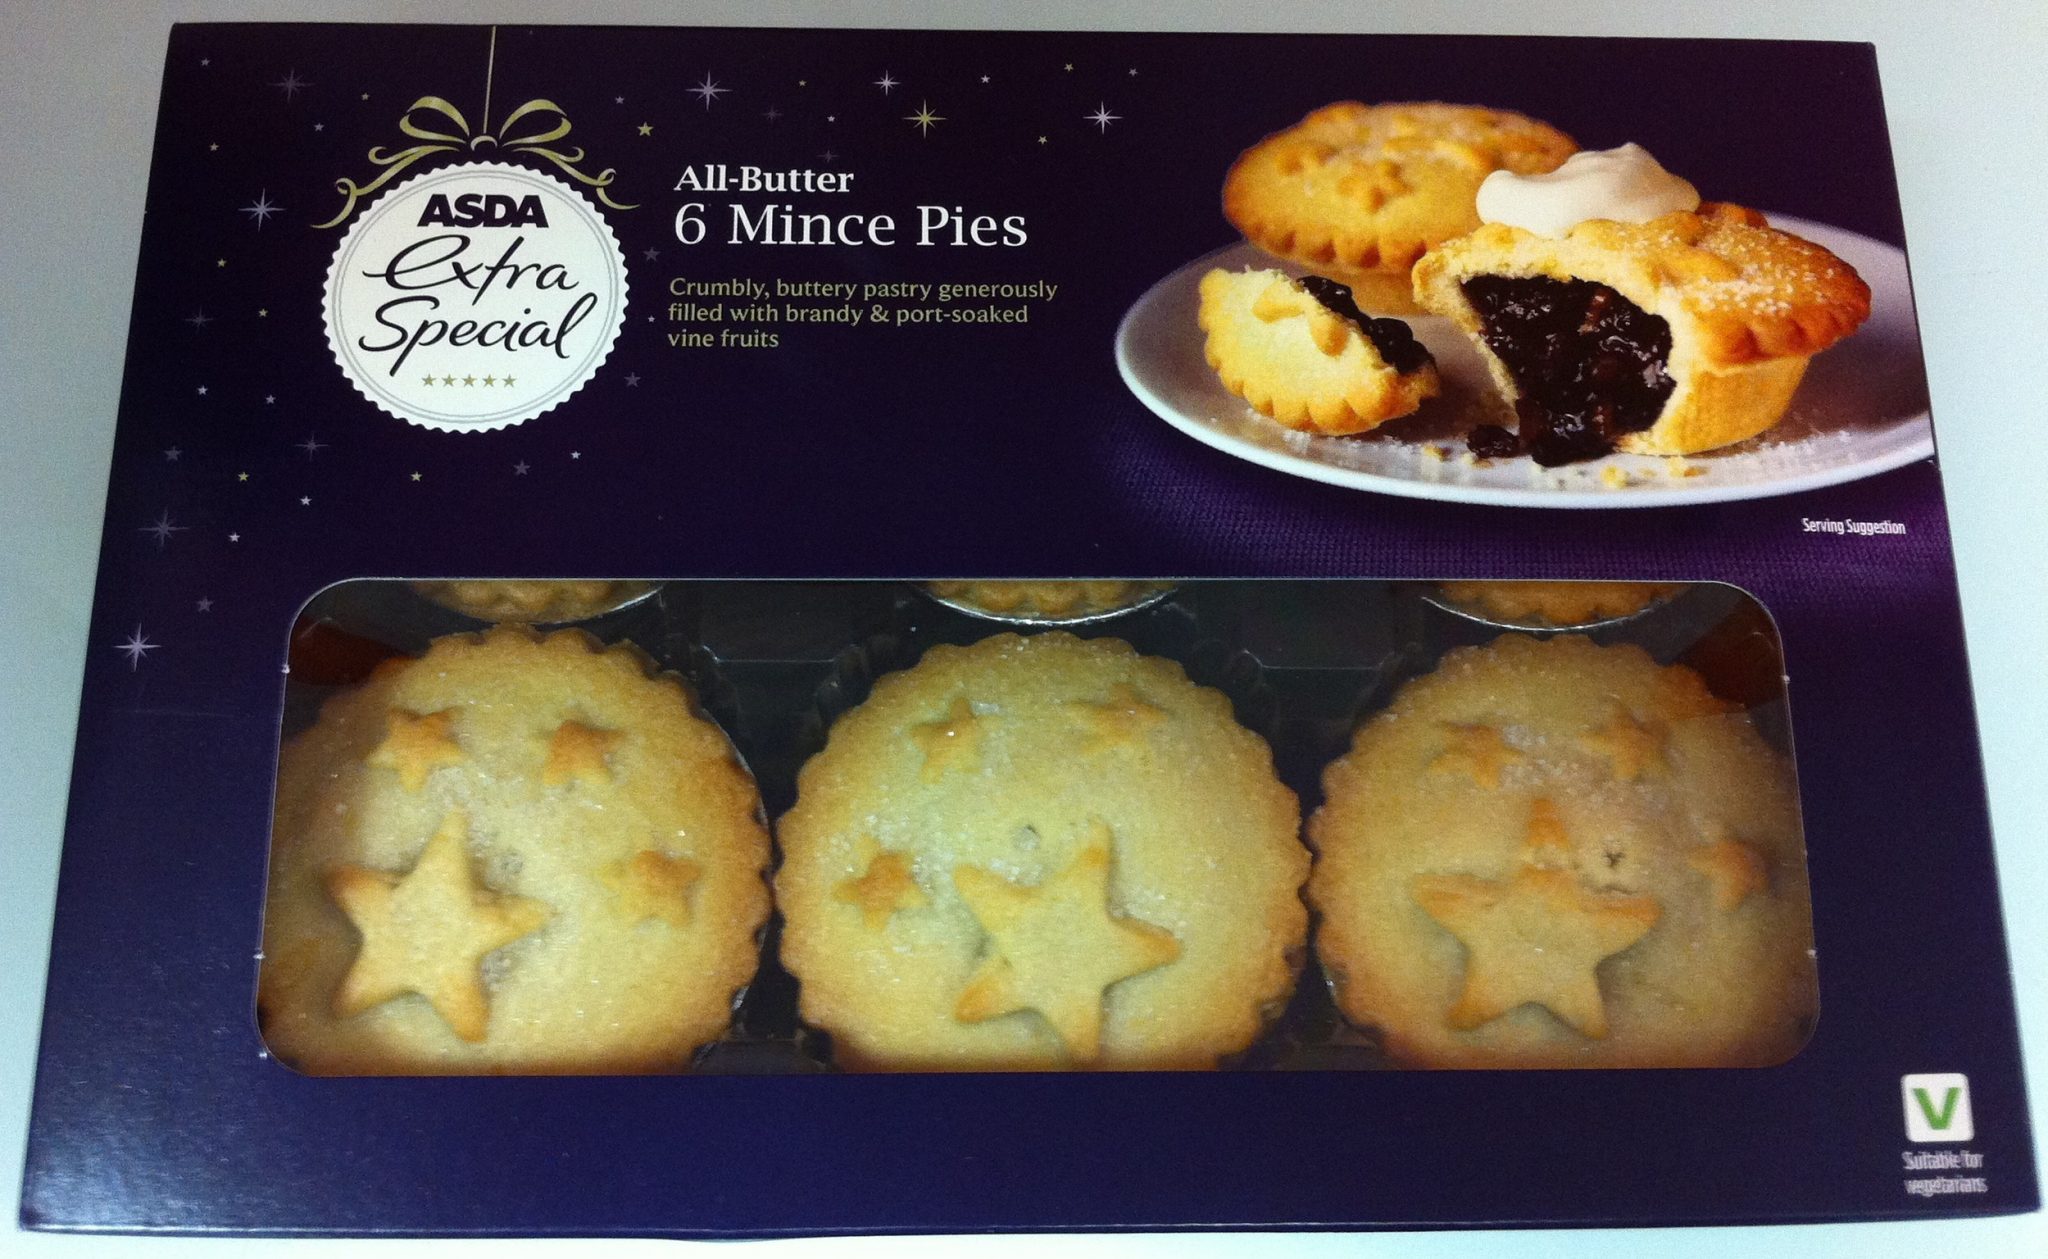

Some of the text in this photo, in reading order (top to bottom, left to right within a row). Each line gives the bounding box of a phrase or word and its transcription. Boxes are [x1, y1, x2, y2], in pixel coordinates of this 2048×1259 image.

[673, 164, 855, 193] All-Butter
[417, 193, 549, 228] ASDA
[674, 202, 1028, 247] 6 Mince Pies
[669, 277, 1058, 301] Crumbly, buttery pastry generously
[668, 302, 1028, 326] filled with brandy & port-soaked
[358, 292, 598, 377] Special
[668, 328, 779, 348] vine fruits
[1802, 518, 1906, 536] Serving Suggestion
[1911, 1087, 1962, 1130] V
[1902, 1150, 1984, 1170] Suitable for
[1904, 1176, 1988, 1197] vegetarians
